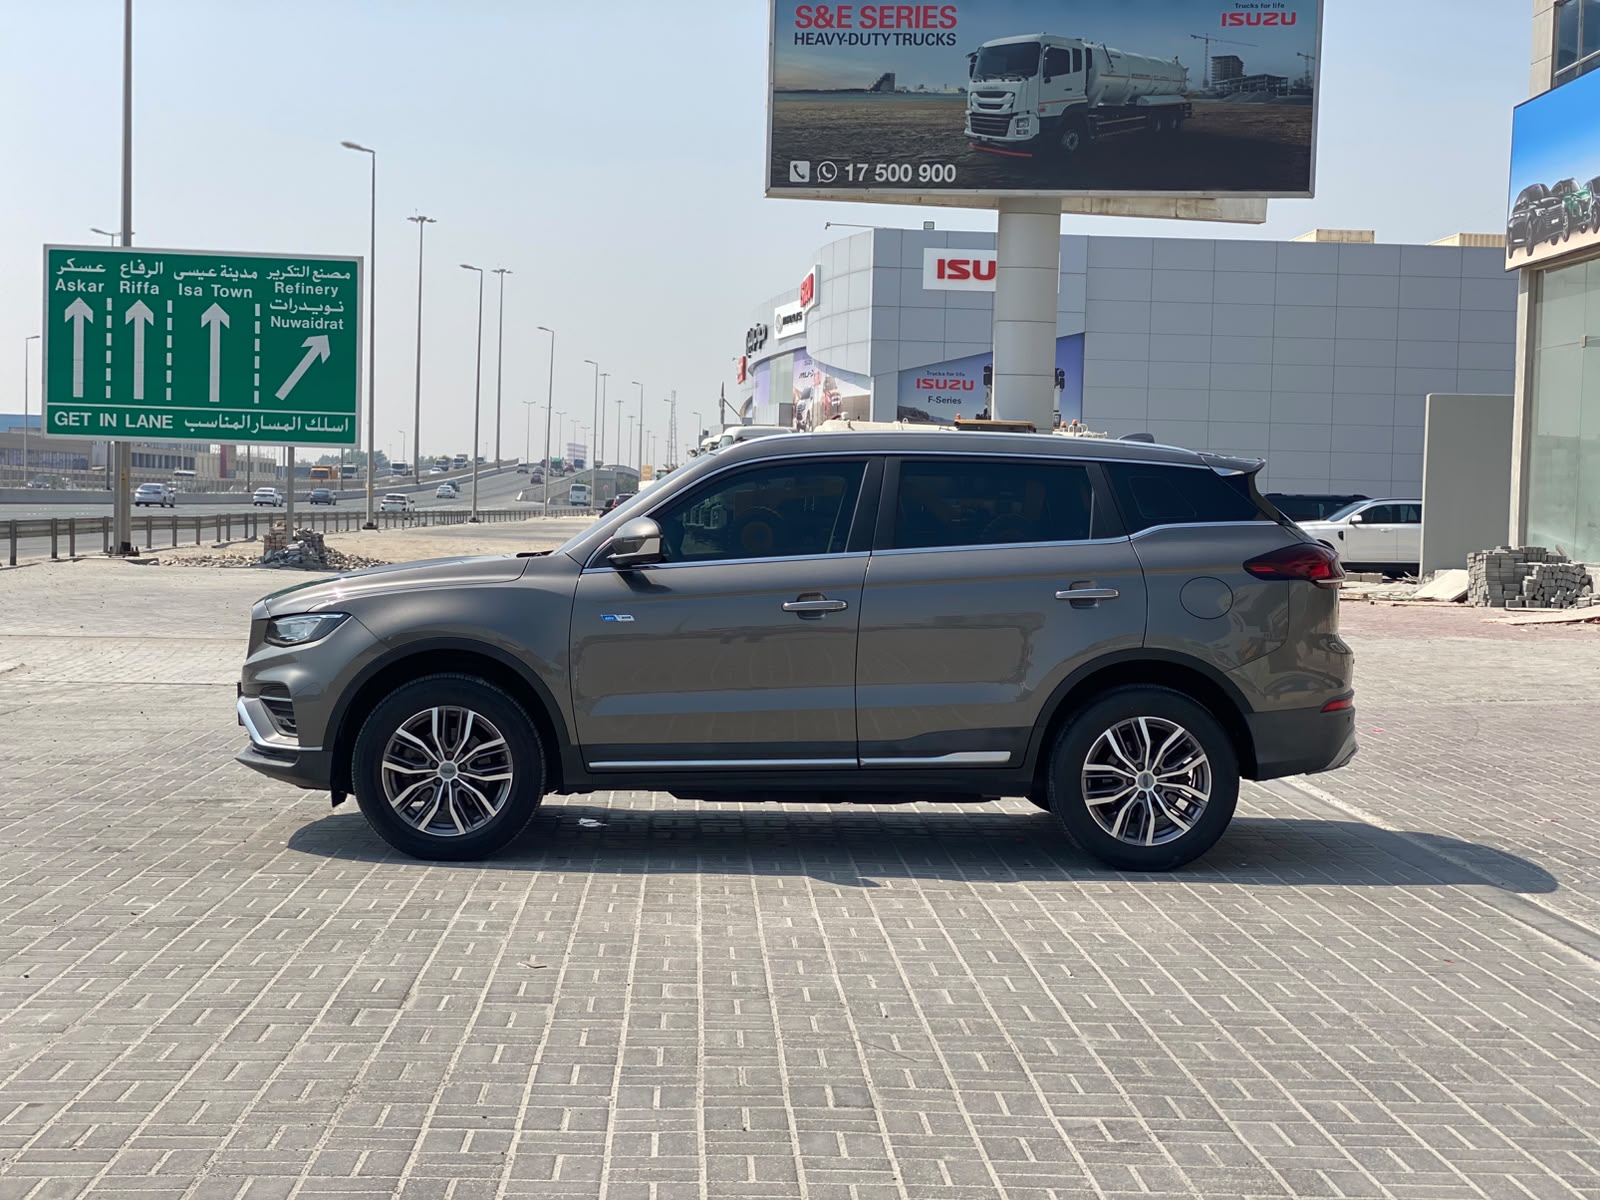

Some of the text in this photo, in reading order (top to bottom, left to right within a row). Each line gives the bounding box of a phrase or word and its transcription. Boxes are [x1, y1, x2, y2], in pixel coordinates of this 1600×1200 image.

[795, 5, 957, 29] S&E SERIES
[1221, 12, 1296, 27] ISUZU
[794, 33, 956, 46] HEAVY-DUTY TRUCKS
[845, 163, 956, 183] 17 500 900
[56, 257, 107, 275] عسكر
[120, 259, 164, 279] الرفاع
[173, 264, 258, 282] مدينة عيسى
[266, 264, 351, 283] مصنع التكرير
[937, 259, 997, 281] ISU
[55, 278, 104, 293] Askar
[119, 280, 160, 295] Riffa
[178, 283, 253, 299] Isa Town
[274, 281, 339, 298] Refinery
[269, 297, 345, 315] نويدرات
[270, 315, 344, 330] Nuwaidrat
[916, 378, 974, 391] ISUZU
[928, 395, 962, 405] F-Series
[54, 411, 174, 430] GET IN LANE
[184, 413, 349, 434] اسلك المسار المناسب
